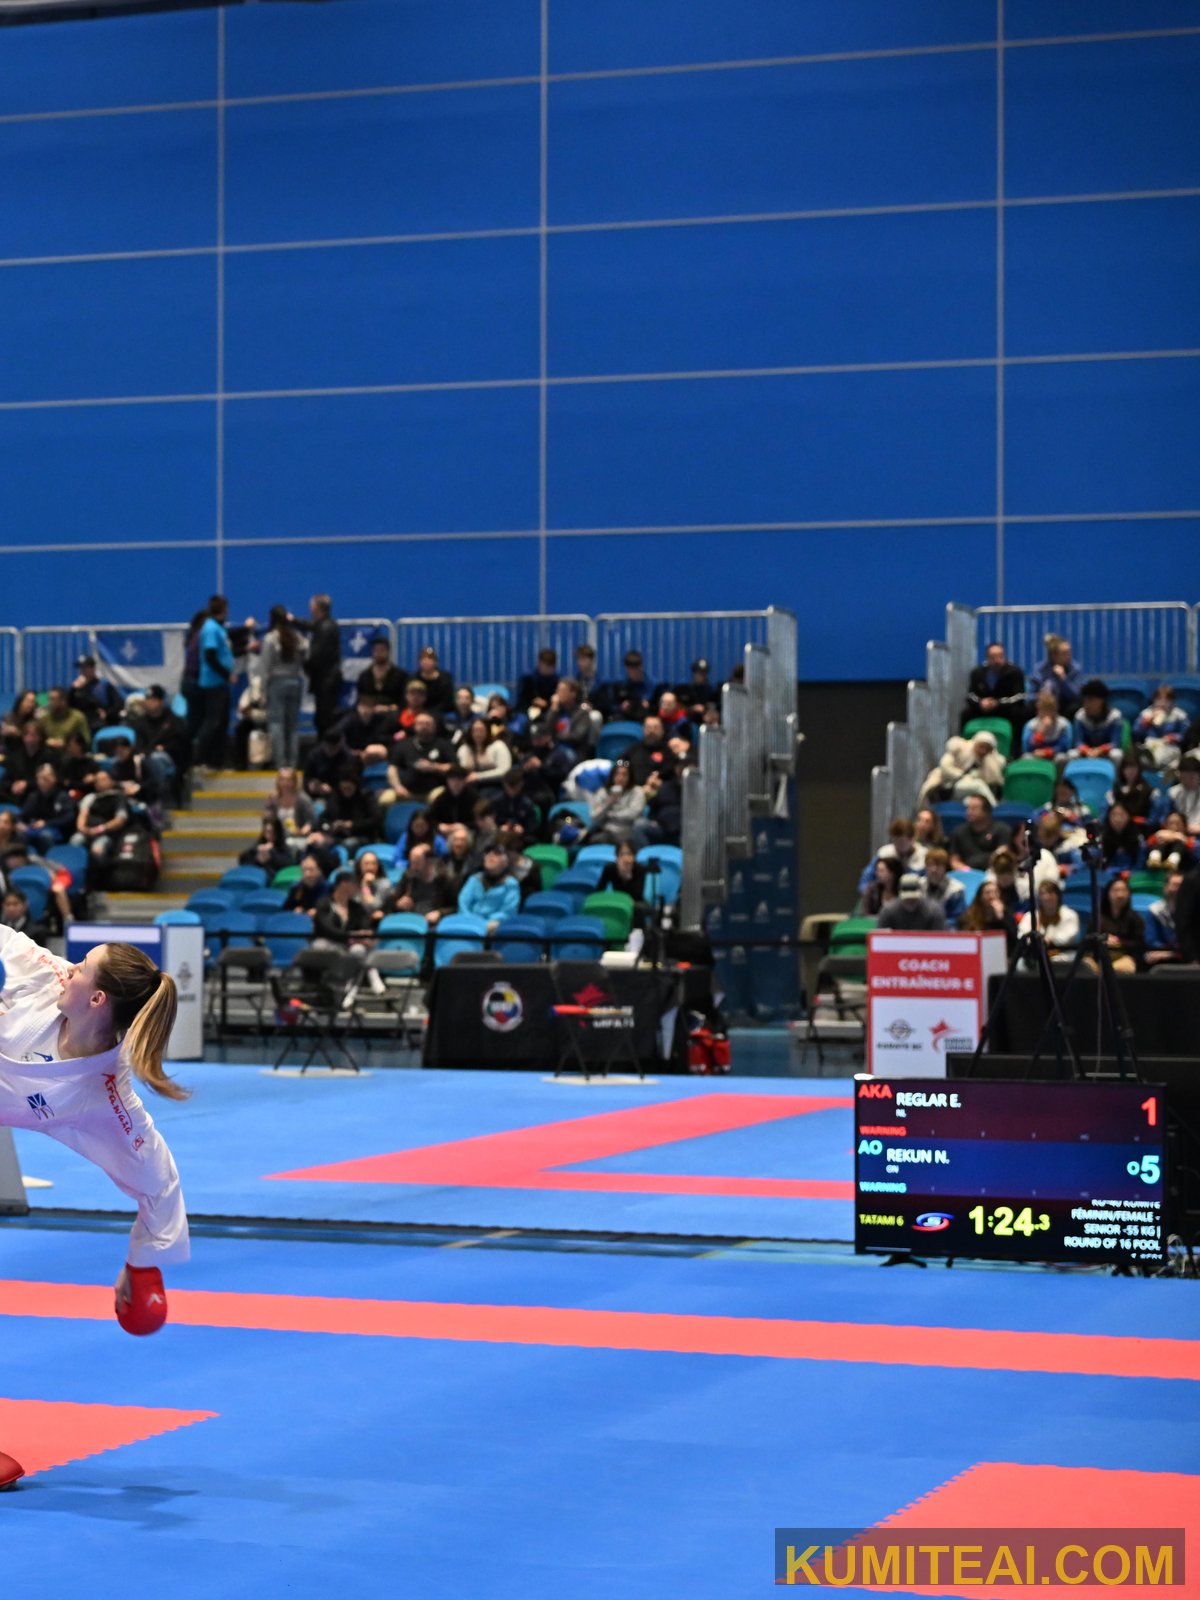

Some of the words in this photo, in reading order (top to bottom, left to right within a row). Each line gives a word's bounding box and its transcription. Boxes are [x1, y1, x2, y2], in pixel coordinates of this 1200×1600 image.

[898, 959, 950, 972] COACH
[858, 1083, 893, 1099] AKA
[895, 1092, 947, 1108] REGLAR
[949, 1093, 962, 1108] E.
[1141, 1096, 1157, 1127] 1
[859, 1125, 907, 1137] WARNING
[858, 1139, 883, 1155] AO
[886, 1148, 932, 1164] REKUN
[934, 1149, 950, 1164] N.
[859, 1181, 907, 1194] WARNING
[859, 1213, 896, 1227] TATAMI
[896, 1215, 905, 1227] 6
[1083, 1222, 1121, 1235] SENIOR
[1140, 1225, 1156, 1237] KG
[1063, 1236, 1102, 1249] ROUND
[1102, 1237, 1118, 1249] OF
[1119, 1238, 1133, 1250] 16
[1132, 1239, 1162, 1251] POOL
